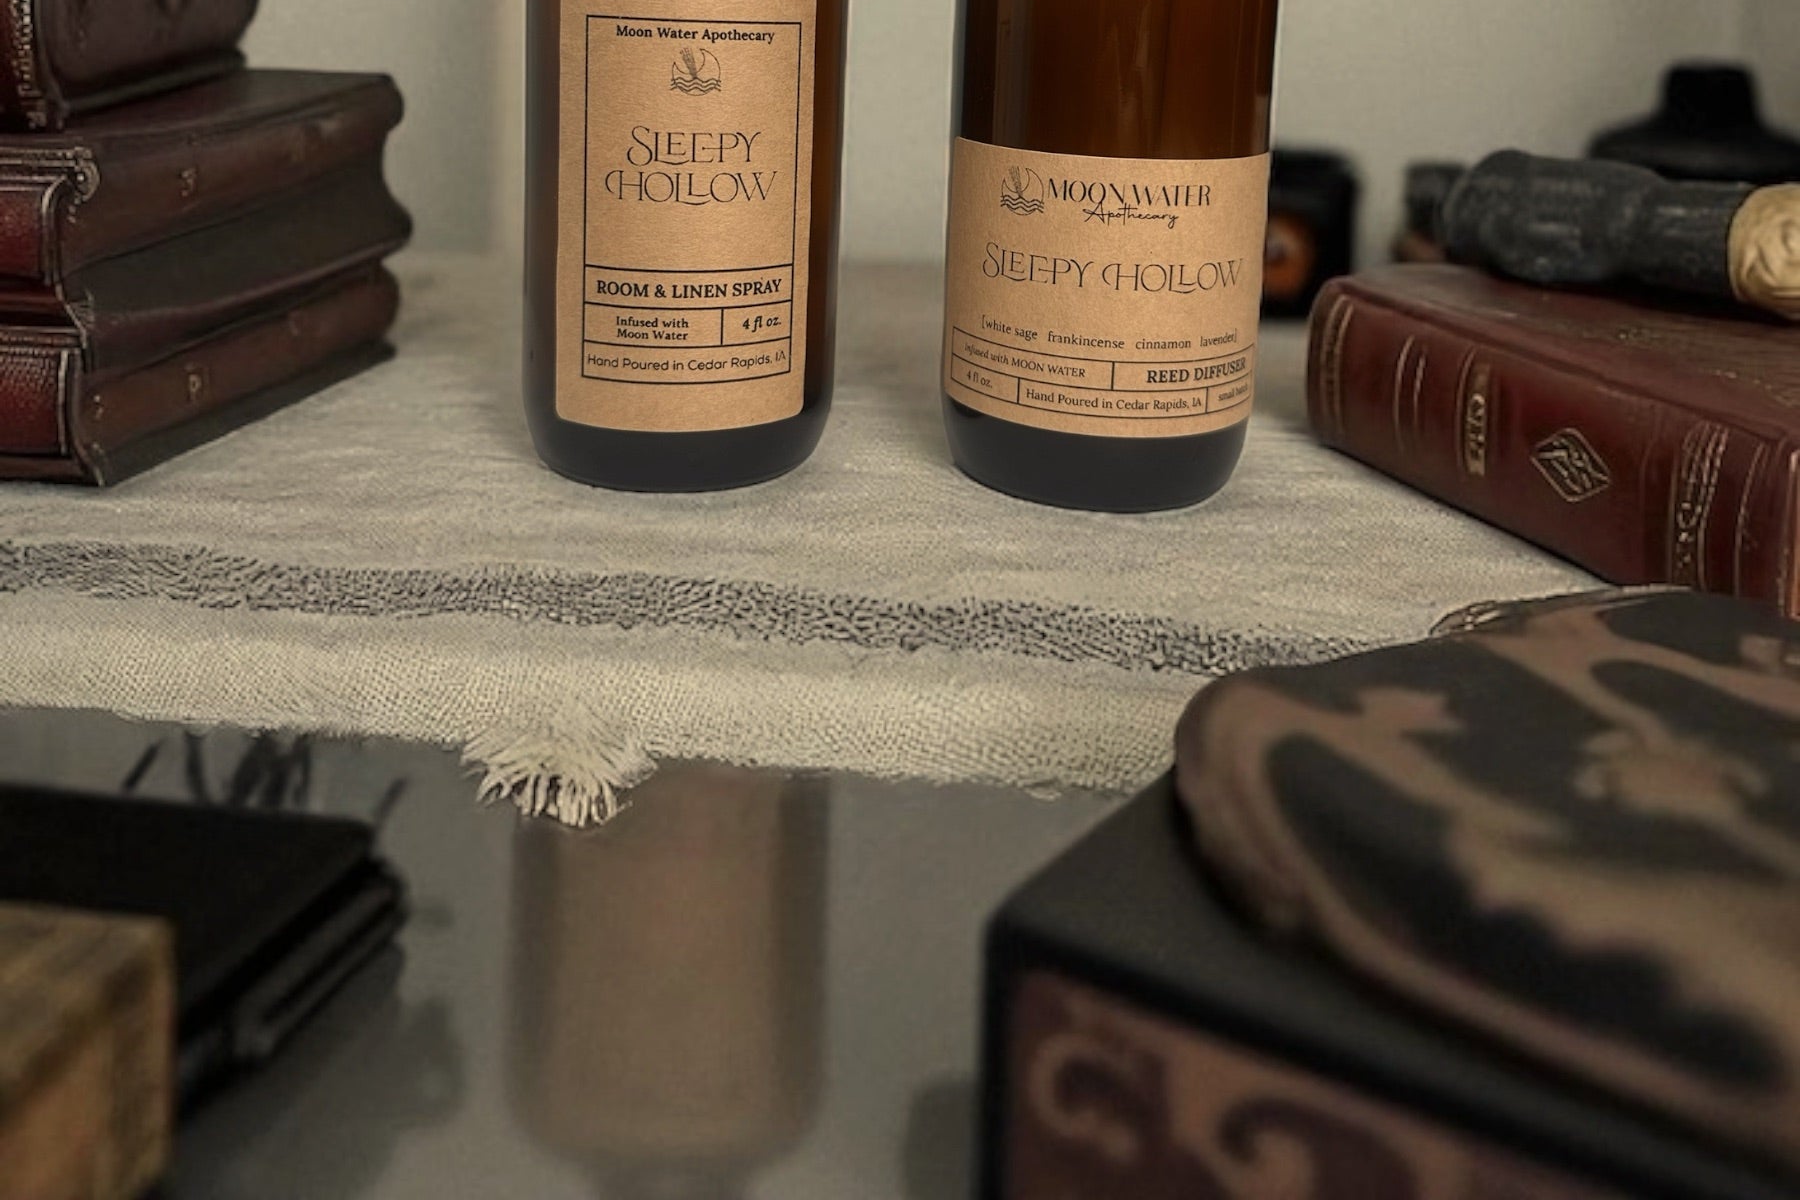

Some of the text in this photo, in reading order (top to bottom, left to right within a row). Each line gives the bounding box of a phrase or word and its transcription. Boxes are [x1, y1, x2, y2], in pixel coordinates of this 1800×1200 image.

[616, 25, 775, 44] Moon Water Apothecary
[626, 125, 762, 167] SLEEPY
[604, 169, 778, 206] HOLLOW
[1082, 200, 1180, 229] Apothecary
[982, 241, 1243, 294] SLEEPY HOLLOW
[596, 278, 782, 299] ROOM & LINEN SPRAY
[616, 316, 689, 329] Infused with
[742, 316, 782, 332] 4 fl oz.
[617, 330, 689, 341] Moon Water
[1014, 328, 1038, 341] sage
[1047, 331, 1125, 350] frankincense
[1135, 338, 1191, 350] cinnamon
[587, 353, 619, 369] Hand
[623, 358, 669, 372] Poured
[673, 359, 684, 372] in
[688, 357, 727, 372] Cedar
[775, 349, 787, 361] IA
[964, 342, 1086, 378] infused with MOON WATER
[1146, 356, 1246, 384] REED DIFFUSER
[966, 370, 993, 389] 4 fl oz.
[1026, 388, 1054, 404] Hand
[1058, 394, 1098, 409] Poured
[1102, 399, 1112, 409] in
[1116, 398, 1150, 410] Cedar
[1192, 397, 1202, 407] IA
